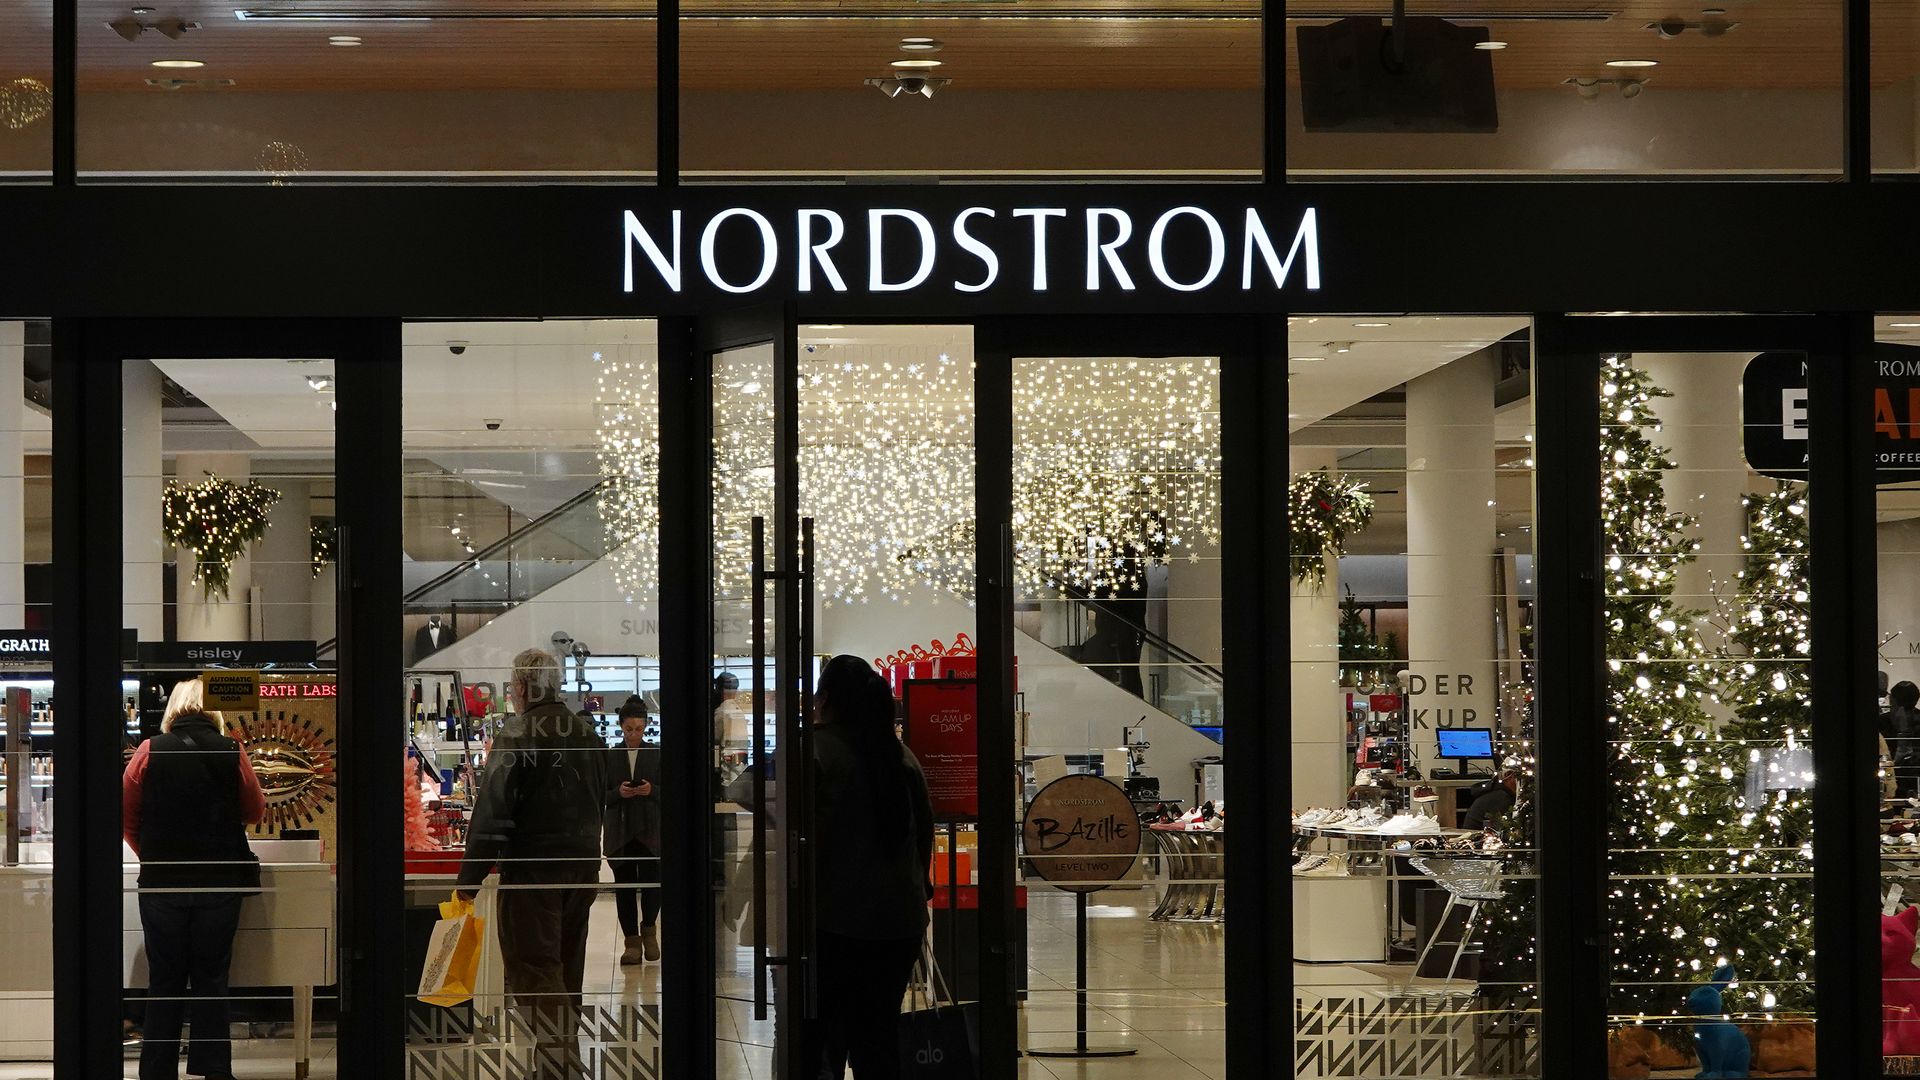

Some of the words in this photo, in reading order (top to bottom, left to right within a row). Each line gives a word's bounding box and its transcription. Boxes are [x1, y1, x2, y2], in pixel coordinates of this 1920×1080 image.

[623, 207, 1321, 293] NORDSTROM
[1875, 453, 1920, 463] OFFEE
[187, 647, 242, 661] sisley
[212, 685, 250, 694] CAUTION
[930, 714, 958, 724] GLAM
[959, 713, 972, 723] UP
[940, 723, 964, 733] DAYS
[500, 751, 537, 768] ON
[551, 751, 563, 768] 2
[1055, 863, 1083, 871] LEVEL
[1086, 863, 1109, 872] TWO
[915, 1040, 944, 1064] alo
